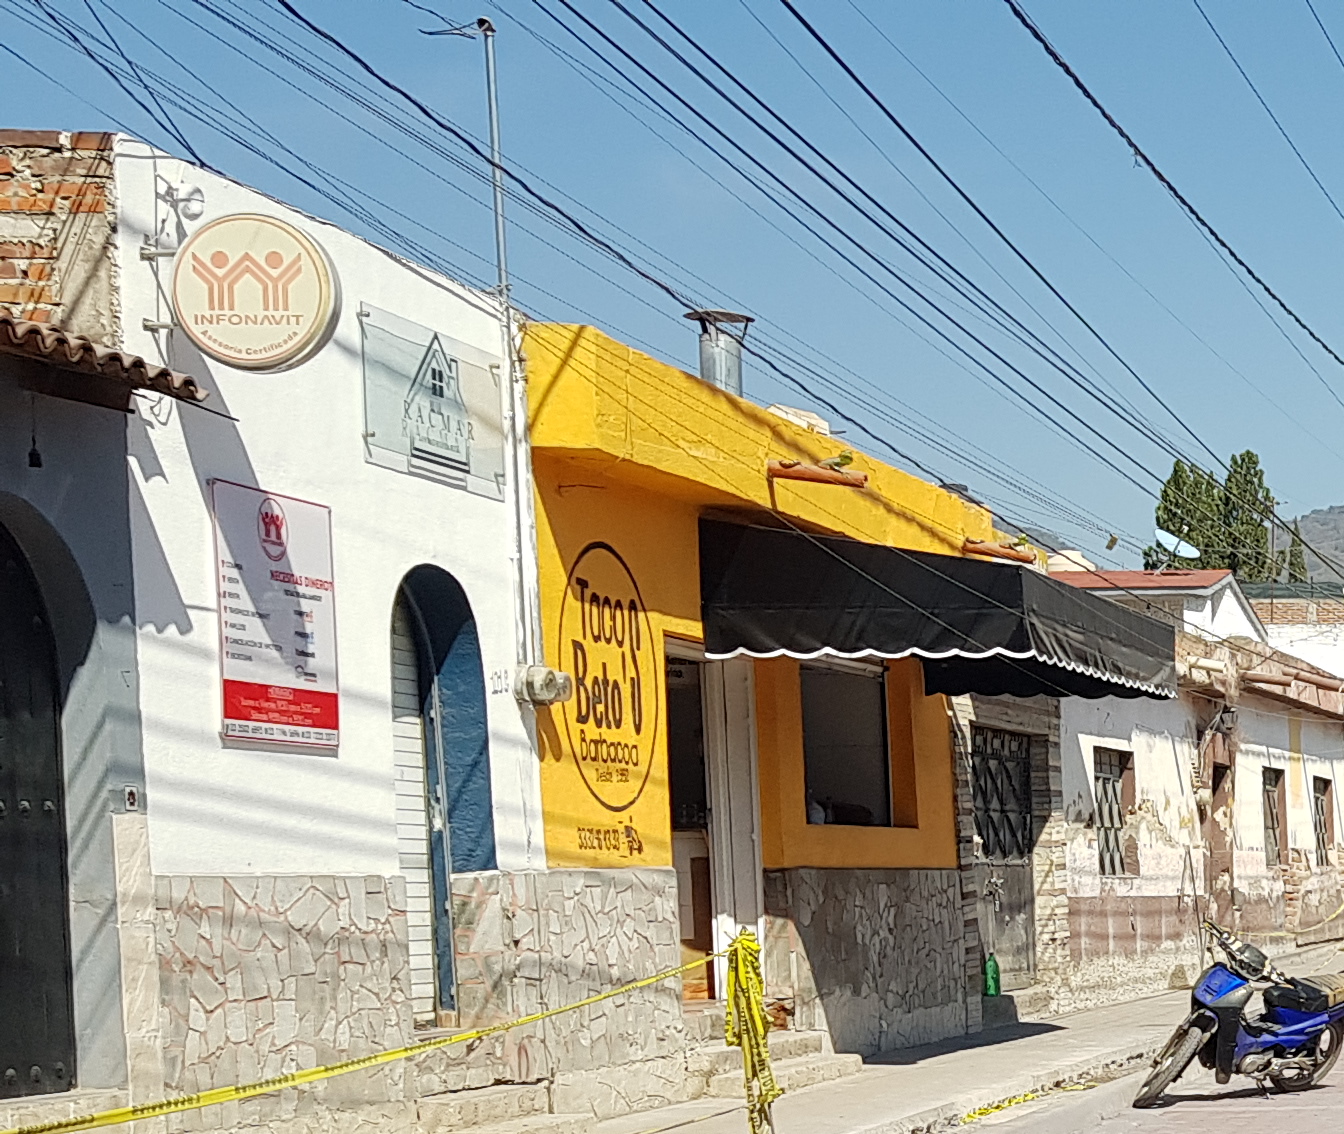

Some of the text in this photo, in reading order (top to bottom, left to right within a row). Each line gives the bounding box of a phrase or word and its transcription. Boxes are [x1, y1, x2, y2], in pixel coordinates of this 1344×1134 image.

[193, 313, 304, 326] INFONAVIT
[245, 330, 299, 356] Certificada
[403, 399, 475, 441] RACMAR
[580, 729, 639, 767] Barbacoa
